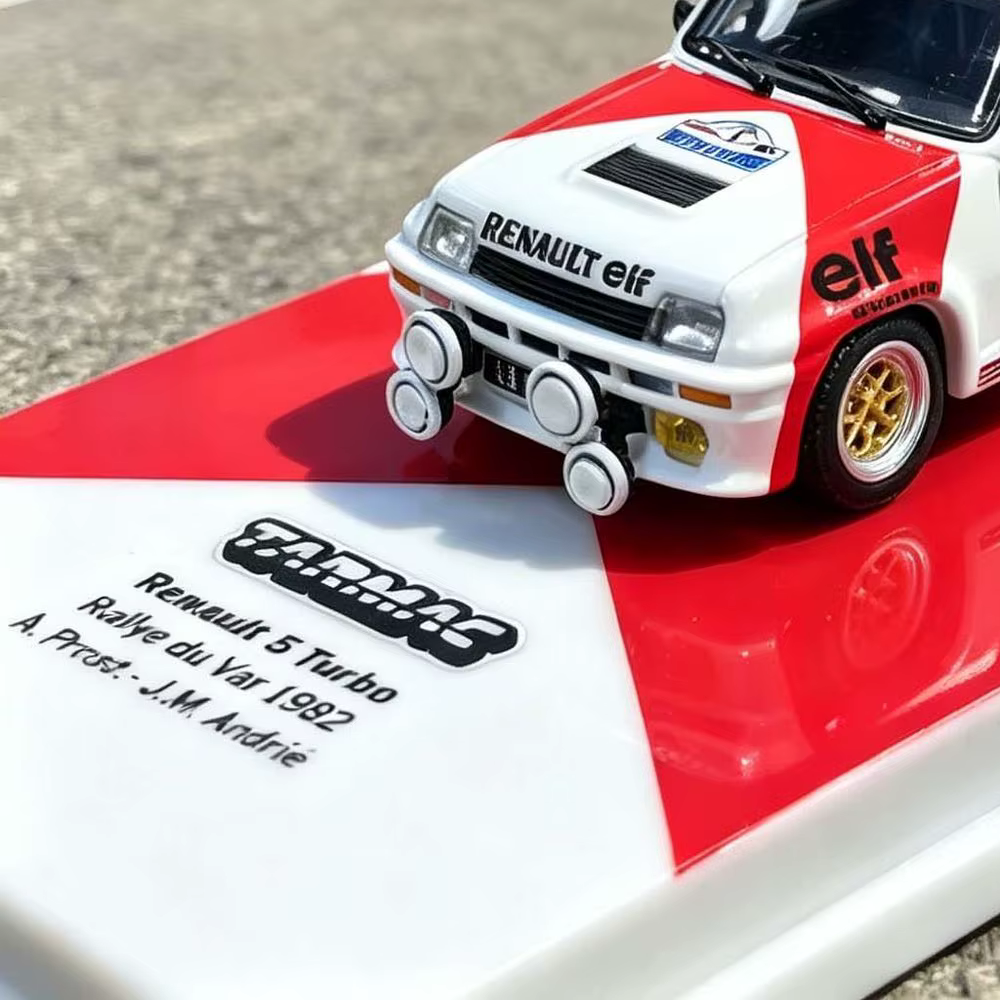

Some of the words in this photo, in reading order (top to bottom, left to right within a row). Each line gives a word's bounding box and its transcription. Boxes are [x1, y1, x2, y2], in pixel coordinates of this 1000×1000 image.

[479, 211, 602, 279] RENAULT
[602, 260, 656, 297] elf
[810, 226, 903, 302] elf
[8, 612, 47, 637] A.
[76, 595, 171, 644] Rallye
[164, 641, 214, 667] du
[210, 655, 271, 691] Var
[262, 685, 356, 733] 1982
[263, 634, 304, 654] 5
[294, 646, 399, 704] Turbo
